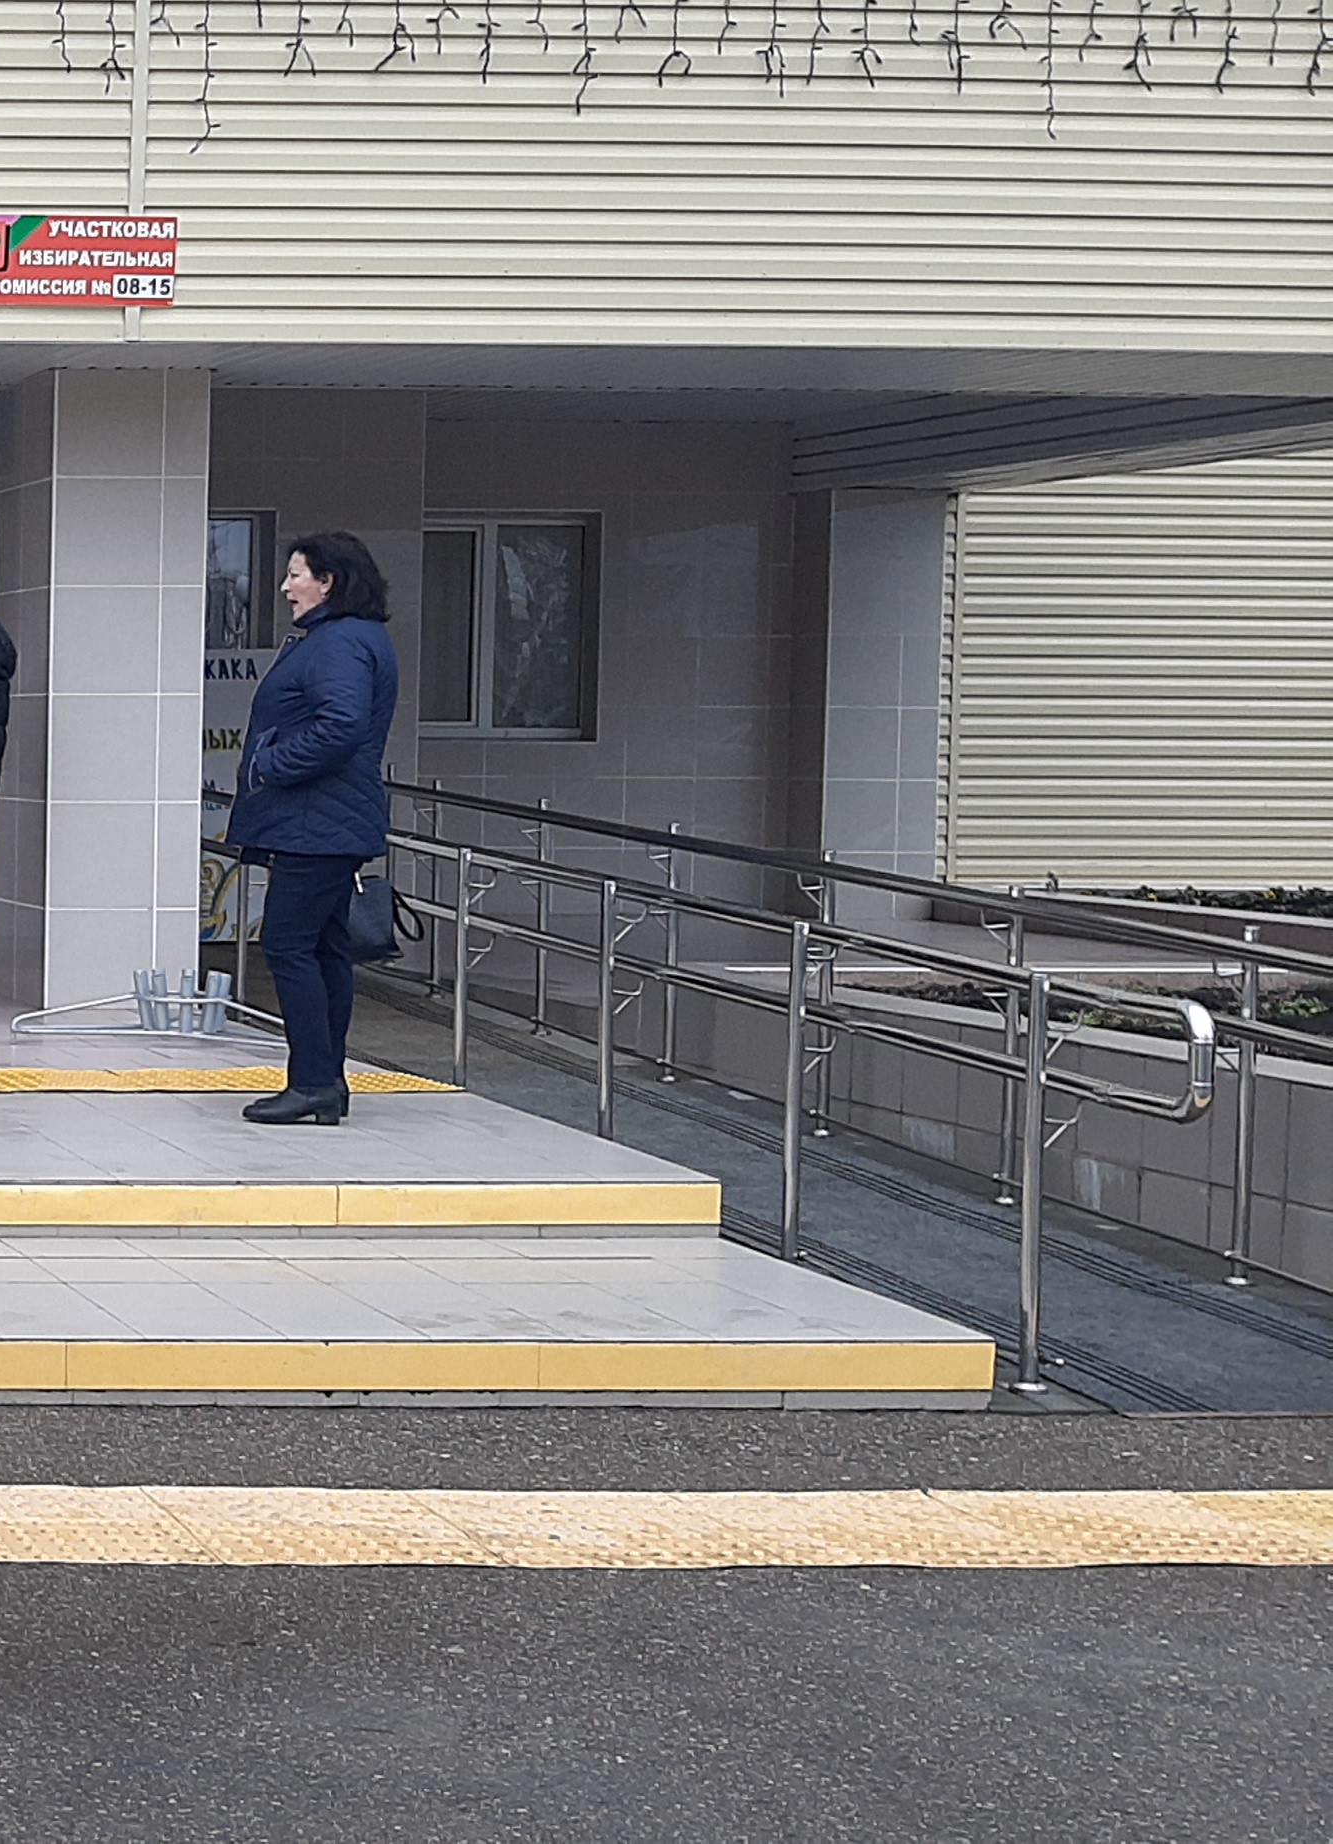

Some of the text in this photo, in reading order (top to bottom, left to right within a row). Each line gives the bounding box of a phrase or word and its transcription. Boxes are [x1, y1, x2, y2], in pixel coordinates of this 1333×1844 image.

[49, 220, 175, 239] УЧАСТКОВАЯ
[19, 250, 174, 267] ИЗБИРАТЕЛЬНАЯ
[116, 277, 171, 296] 08-15
